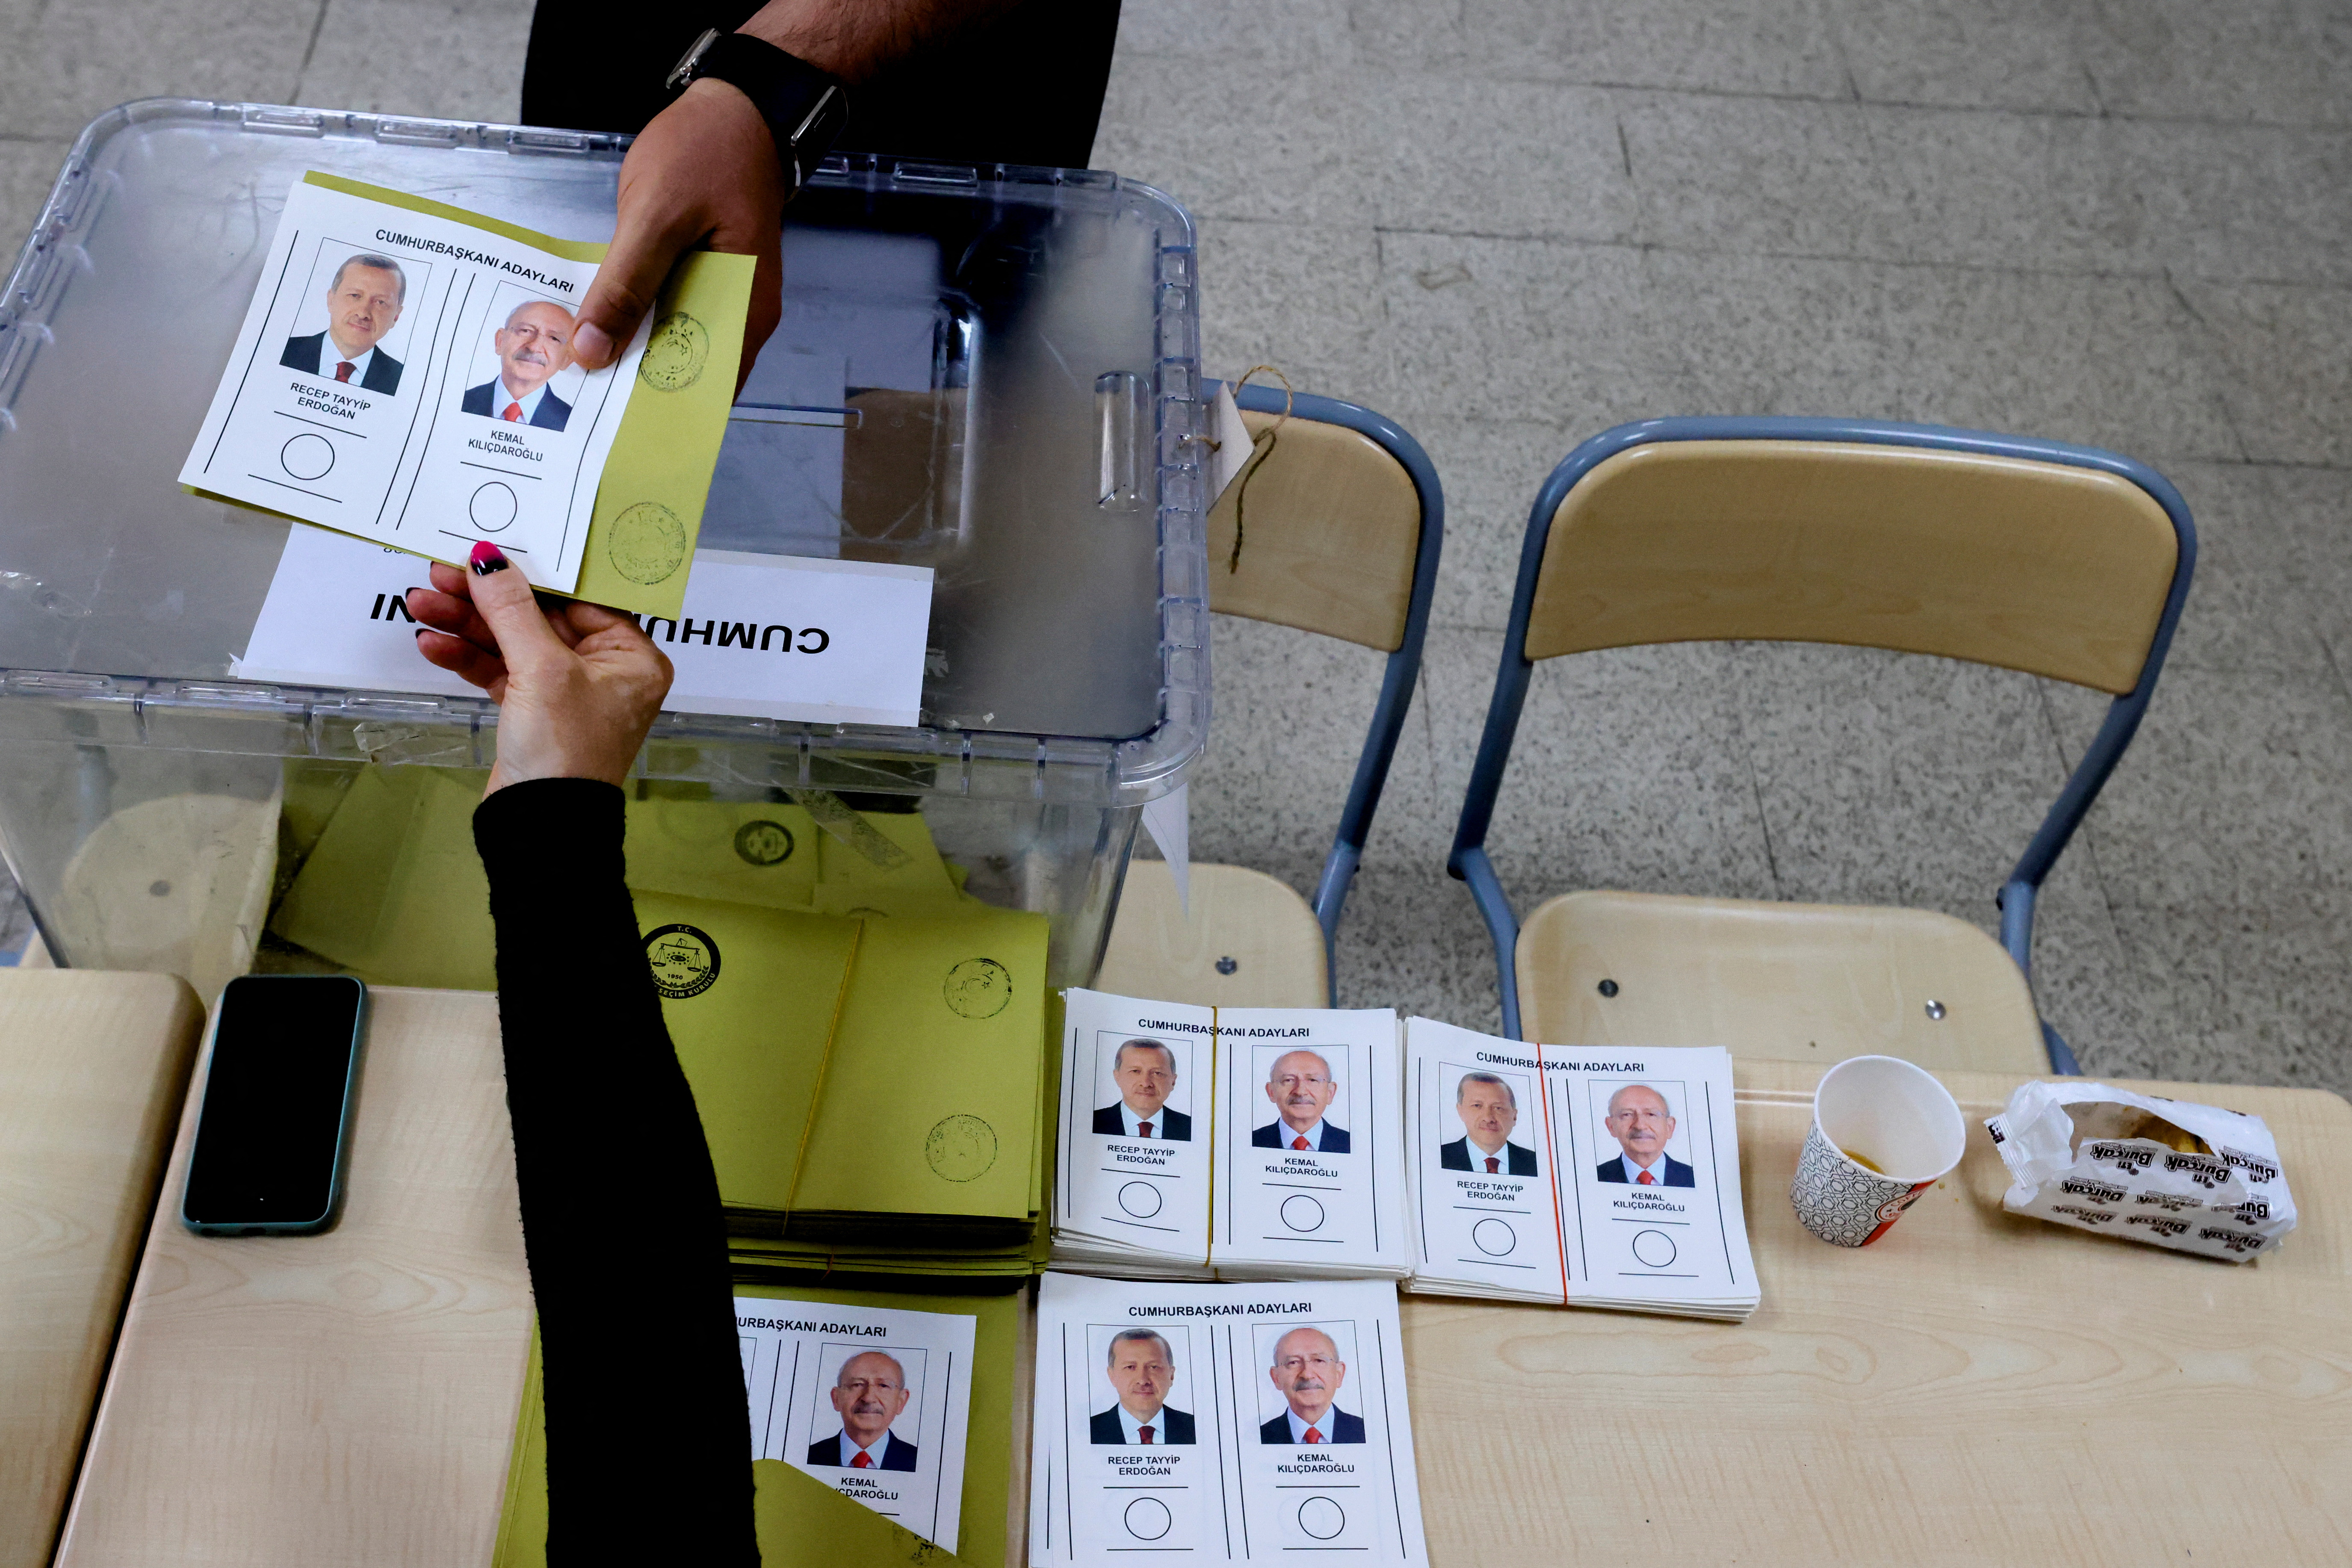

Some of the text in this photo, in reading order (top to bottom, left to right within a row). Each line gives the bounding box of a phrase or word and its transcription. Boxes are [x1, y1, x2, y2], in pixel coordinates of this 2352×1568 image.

[376, 229, 574, 293] CUMHURBAŞKANI ADAYLARI
[290, 382, 371, 410] RECEP TAYYİP
[298, 397, 356, 419] ERDOĞAN
[490, 430, 525, 445] KEMAL
[468, 438, 543, 461] KILIÇDAROĞLU
[658, 973, 715, 998] SEÇİM KURULU
[1138, 1019, 1309, 1037] CUMHURBAŞKANI ADAYLARI
[1476, 1051, 1645, 1072] CUMHURBAŞKANI ADAYLARI
[1107, 1144, 1175, 1157] RECEP TAYYİP
[1117, 1154, 1165, 1165] ERDOĞAN
[1285, 1158, 1318, 1166] KEMAL
[1265, 1165, 1338, 1177] KILIÇDAROĞLU
[1457, 1181, 1524, 1193] RECEP TAYYİP
[1467, 1191, 1515, 1201] ERDOĞAN
[1631, 1192, 1665, 1201] KEMAL
[1613, 1200, 1685, 1212] KILIÇDAROĞLU
[1129, 1302, 1312, 1318] CUMHURBAŞKANI ADAYLARI
[736, 1317, 887, 1337] URBAŞKANI ADAYLARI
[1108, 1455, 1180, 1465] RECEP TAYYİP
[1297, 1454, 1333, 1462] KEMAL
[1119, 1465, 1171, 1475] ERDOĞAN
[1277, 1463, 1354, 1474] KILIÇDAROĞLU
[841, 1477, 878, 1488] KEMAL
[836, 1488, 898, 1500] DAROĞLU
